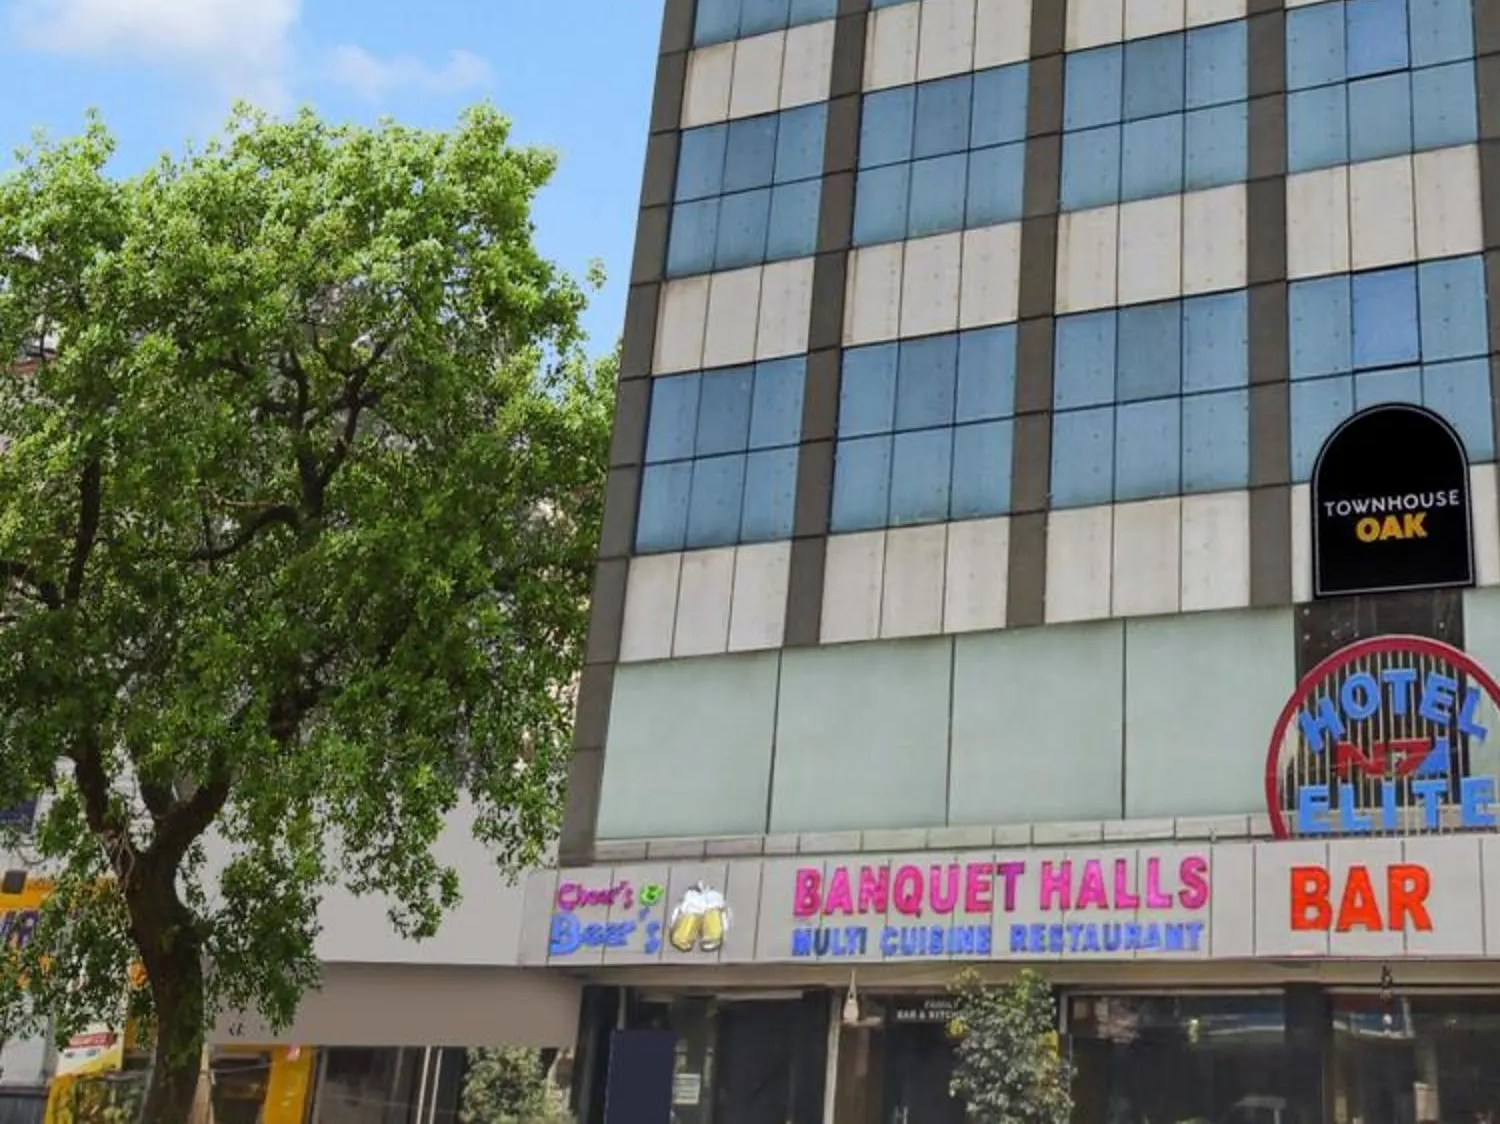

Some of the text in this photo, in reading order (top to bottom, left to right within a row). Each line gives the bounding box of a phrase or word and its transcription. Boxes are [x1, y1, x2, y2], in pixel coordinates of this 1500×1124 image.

[1324, 488, 1460, 518] TOWNHOUSE
[1355, 512, 1428, 543] OAK
[1299, 668, 1489, 754] HOTEL
[1297, 777, 1497, 834] ELITE
[793, 856, 1210, 919] BANQUET HALLS
[1290, 863, 1433, 933] BAR
[791, 921, 1205, 957] MULTI CUISINE RESTAURANT
